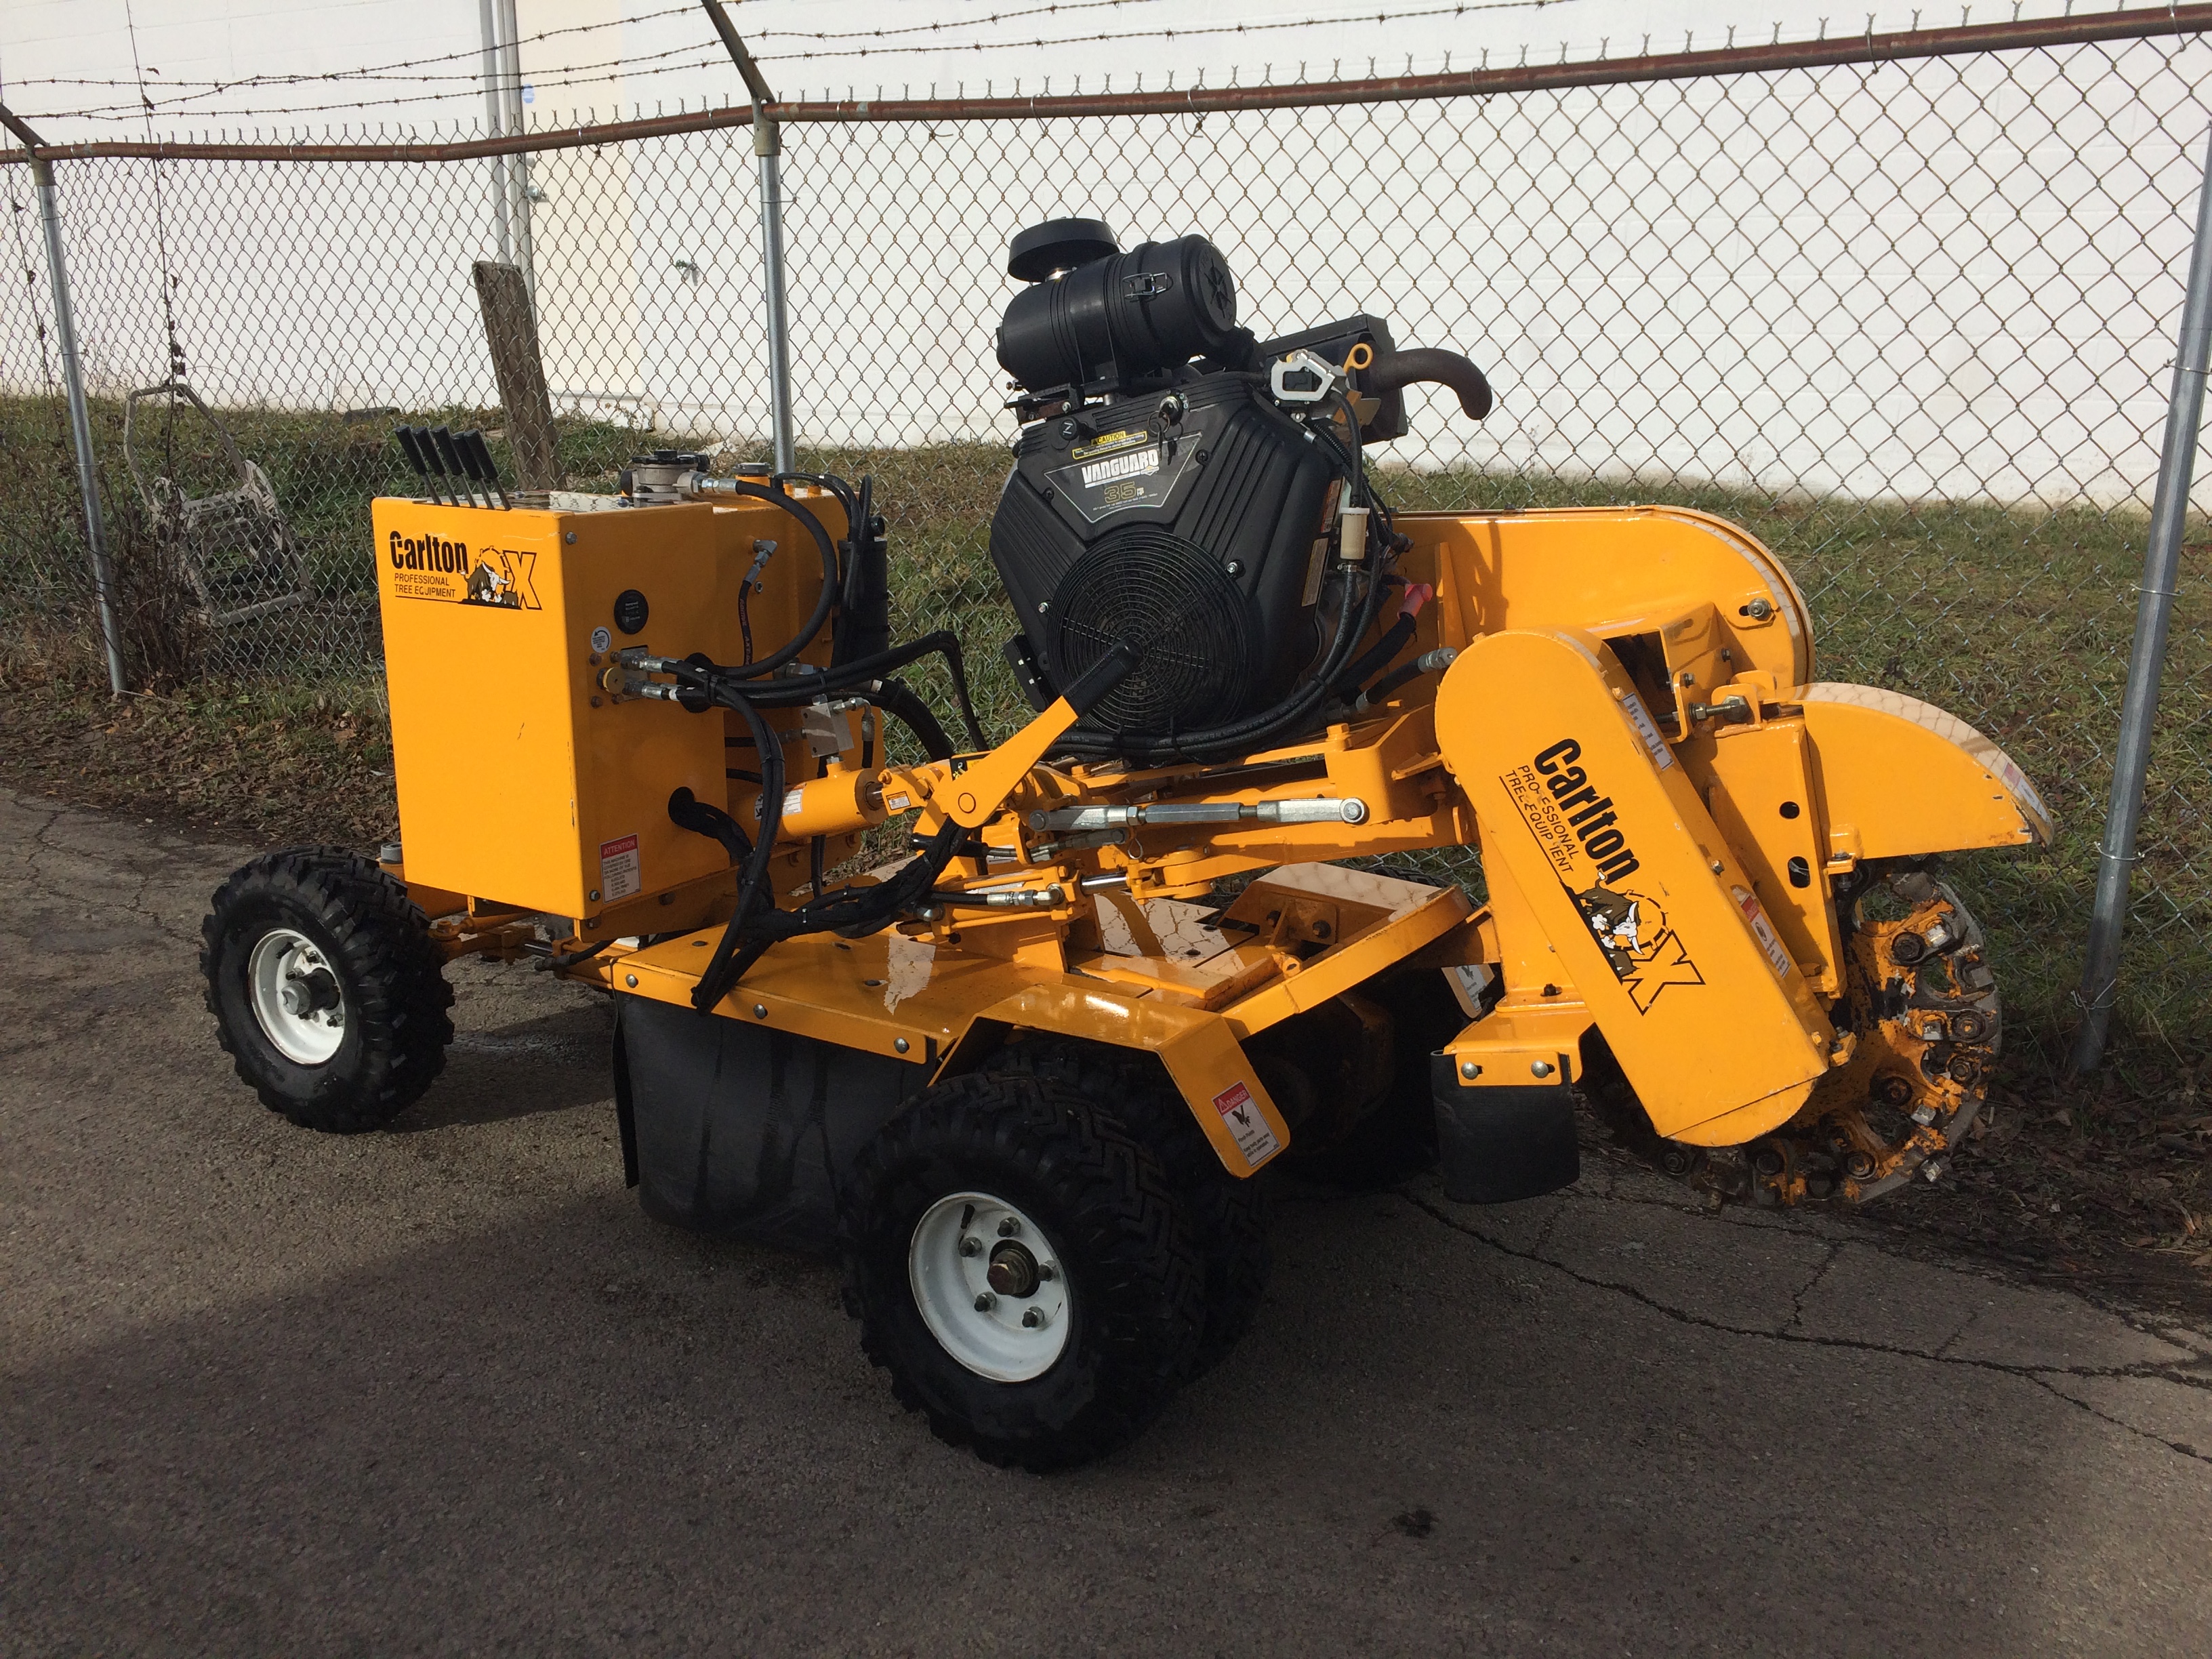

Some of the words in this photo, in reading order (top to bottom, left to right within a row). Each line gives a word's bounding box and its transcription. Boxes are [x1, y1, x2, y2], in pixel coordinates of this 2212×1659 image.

[1098, 432, 1124, 443] CAUTION
[1082, 449, 1159, 483] VANGUARD
[1104, 482, 1136, 503] 35
[390, 531, 469, 574] Carlton
[394, 573, 450, 586] PROFESSIONAL
[394, 583, 413, 594] TREE
[1518, 764, 1580, 860] PROESSIONAL
[1534, 738, 1640, 886] Carlton
[604, 839, 635, 855] ATTENTION
[1227, 1090, 1248, 1107] DANGER
